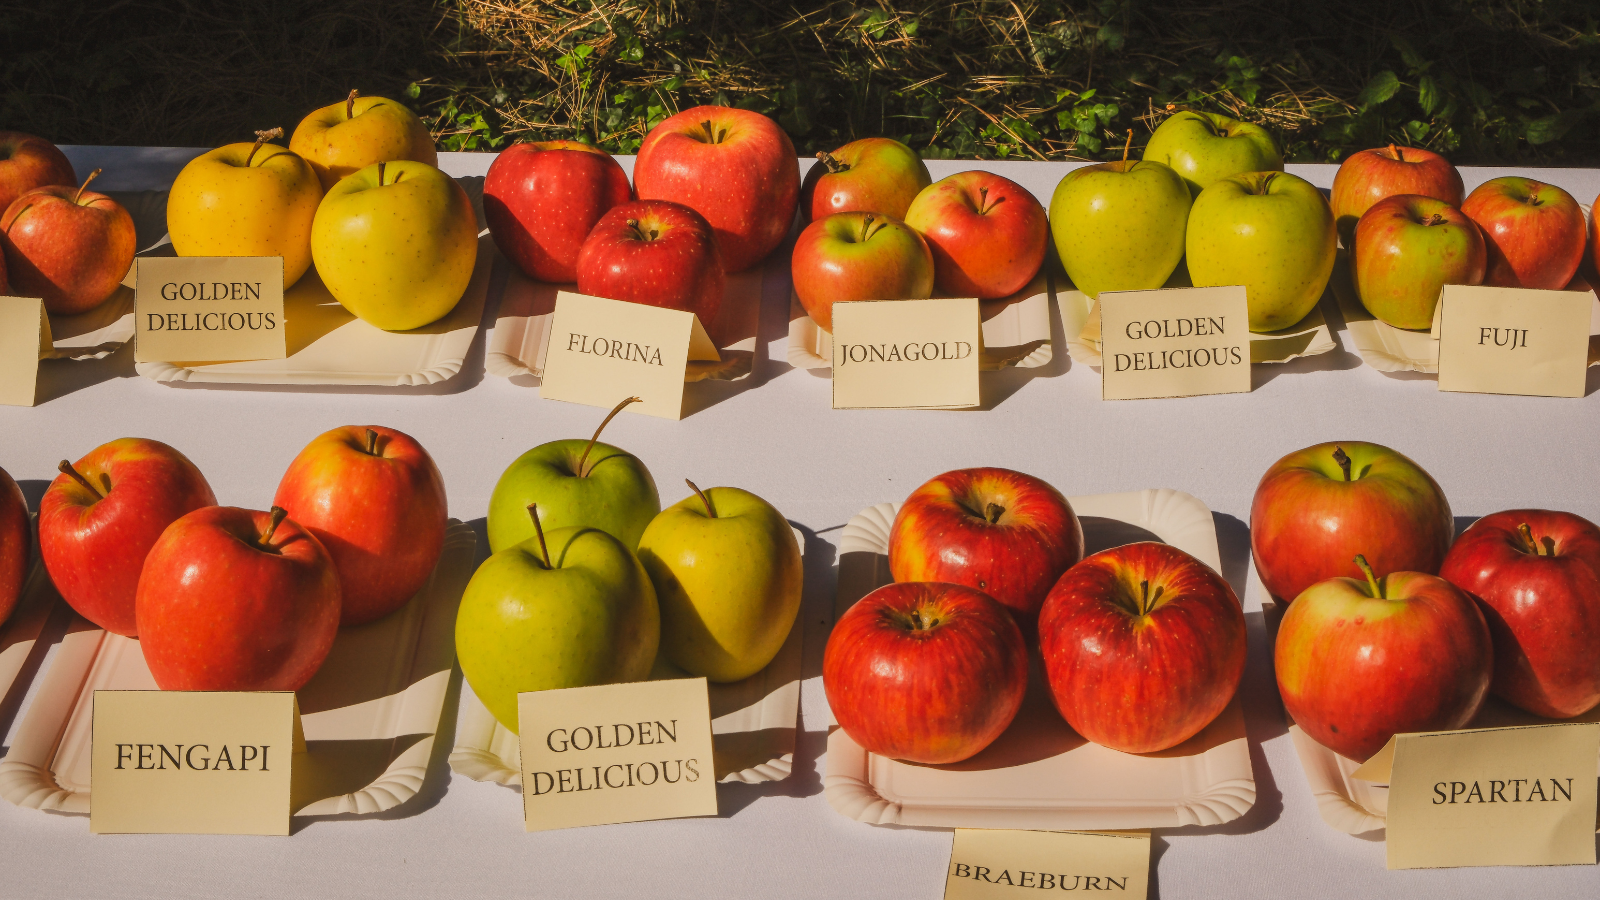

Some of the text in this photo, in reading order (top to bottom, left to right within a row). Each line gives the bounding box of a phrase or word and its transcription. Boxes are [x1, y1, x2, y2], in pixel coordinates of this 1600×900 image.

[160, 282, 262, 301] GOLDEN
[146, 312, 276, 332] DELICIOUS
[1125, 316, 1225, 340] GOLDEN
[566, 332, 664, 367] FLORINA
[1477, 327, 1529, 351] FUJI
[840, 341, 972, 367] JONAGOLD
[1114, 346, 1242, 372] DELICIOUS
[546, 719, 678, 753] GOLDEN
[113, 743, 271, 772] FENGAPI
[530, 758, 700, 796] DELICIOUS
[1432, 778, 1574, 805] SPARTAN
[952, 862, 1129, 891] BRAEBURN
